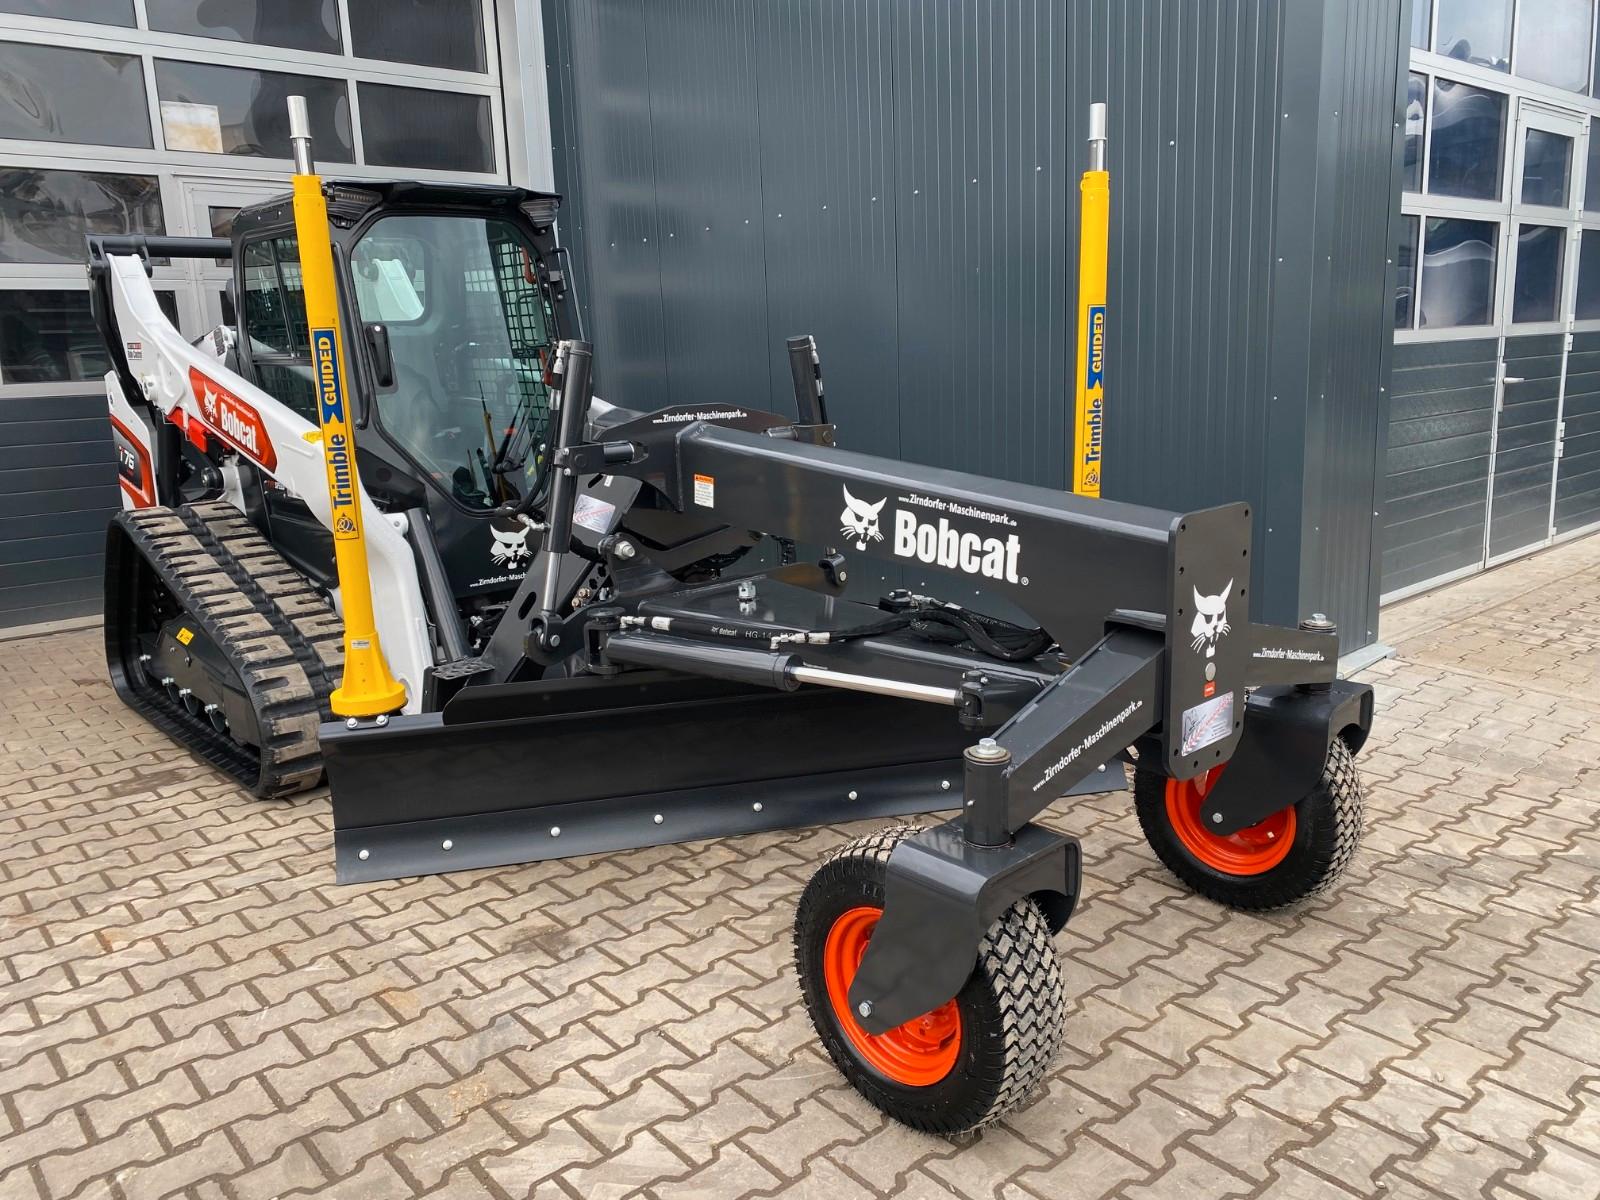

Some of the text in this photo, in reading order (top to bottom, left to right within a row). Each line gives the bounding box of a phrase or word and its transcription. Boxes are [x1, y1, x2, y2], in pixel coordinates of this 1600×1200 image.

[318, 336, 352, 510] Trimble GUIDED
[1085, 312, 1104, 465] Trimble GUIDED
[118, 445, 135, 470] T76
[220, 401, 257, 454] Bobcat
[894, 509, 1021, 584] Bobcat
[898, 493, 1017, 527] www.Zirndorfer-Maschinenpark.de
[1032, 700, 1143, 792] www.Zirndorfer-Maschinenpark.de
